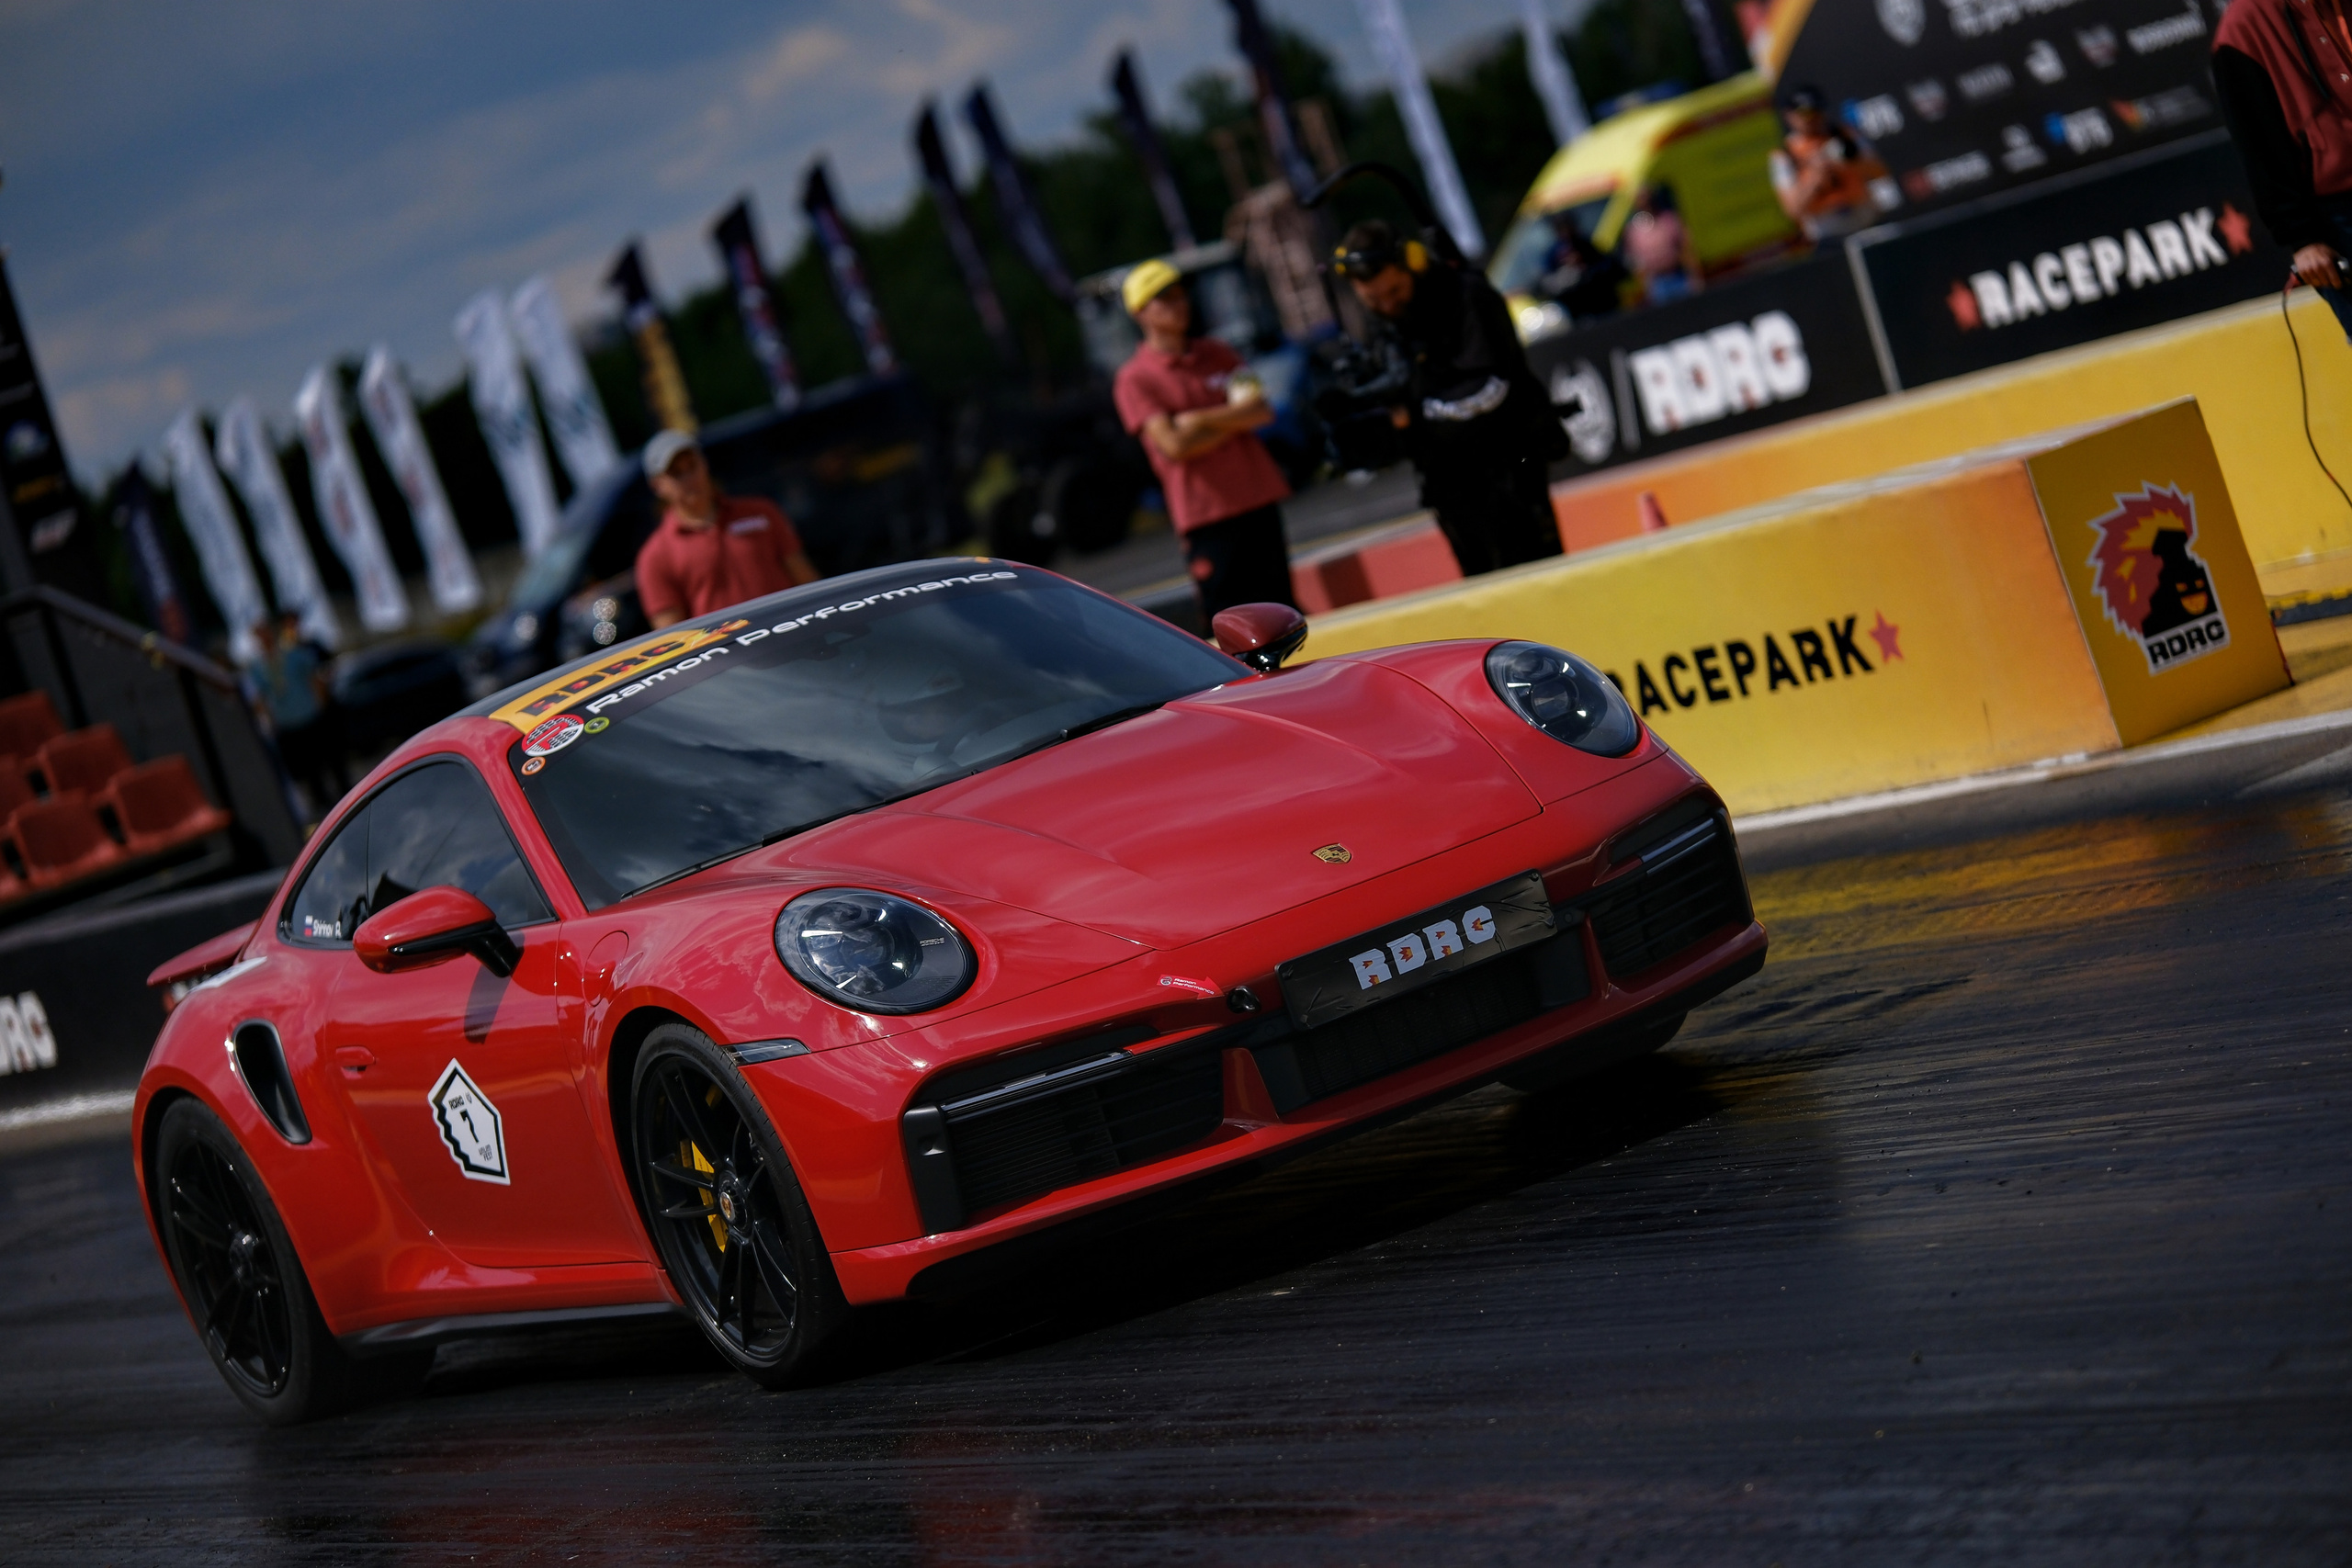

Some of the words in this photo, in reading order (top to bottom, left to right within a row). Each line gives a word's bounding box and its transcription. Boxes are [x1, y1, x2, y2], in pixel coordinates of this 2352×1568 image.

[1969, 207, 2228, 329] RACEPARK
[1630, 310, 1811, 435] RDRC
[585, 647, 729, 714] Ramon
[736, 570, 1018, 646] Performance
[2148, 620, 2225, 663] RDRC
[1173, 981, 1215, 995] Performance
[1348, 905, 1497, 990] RDRC
[0, 990, 58, 1076] RC
